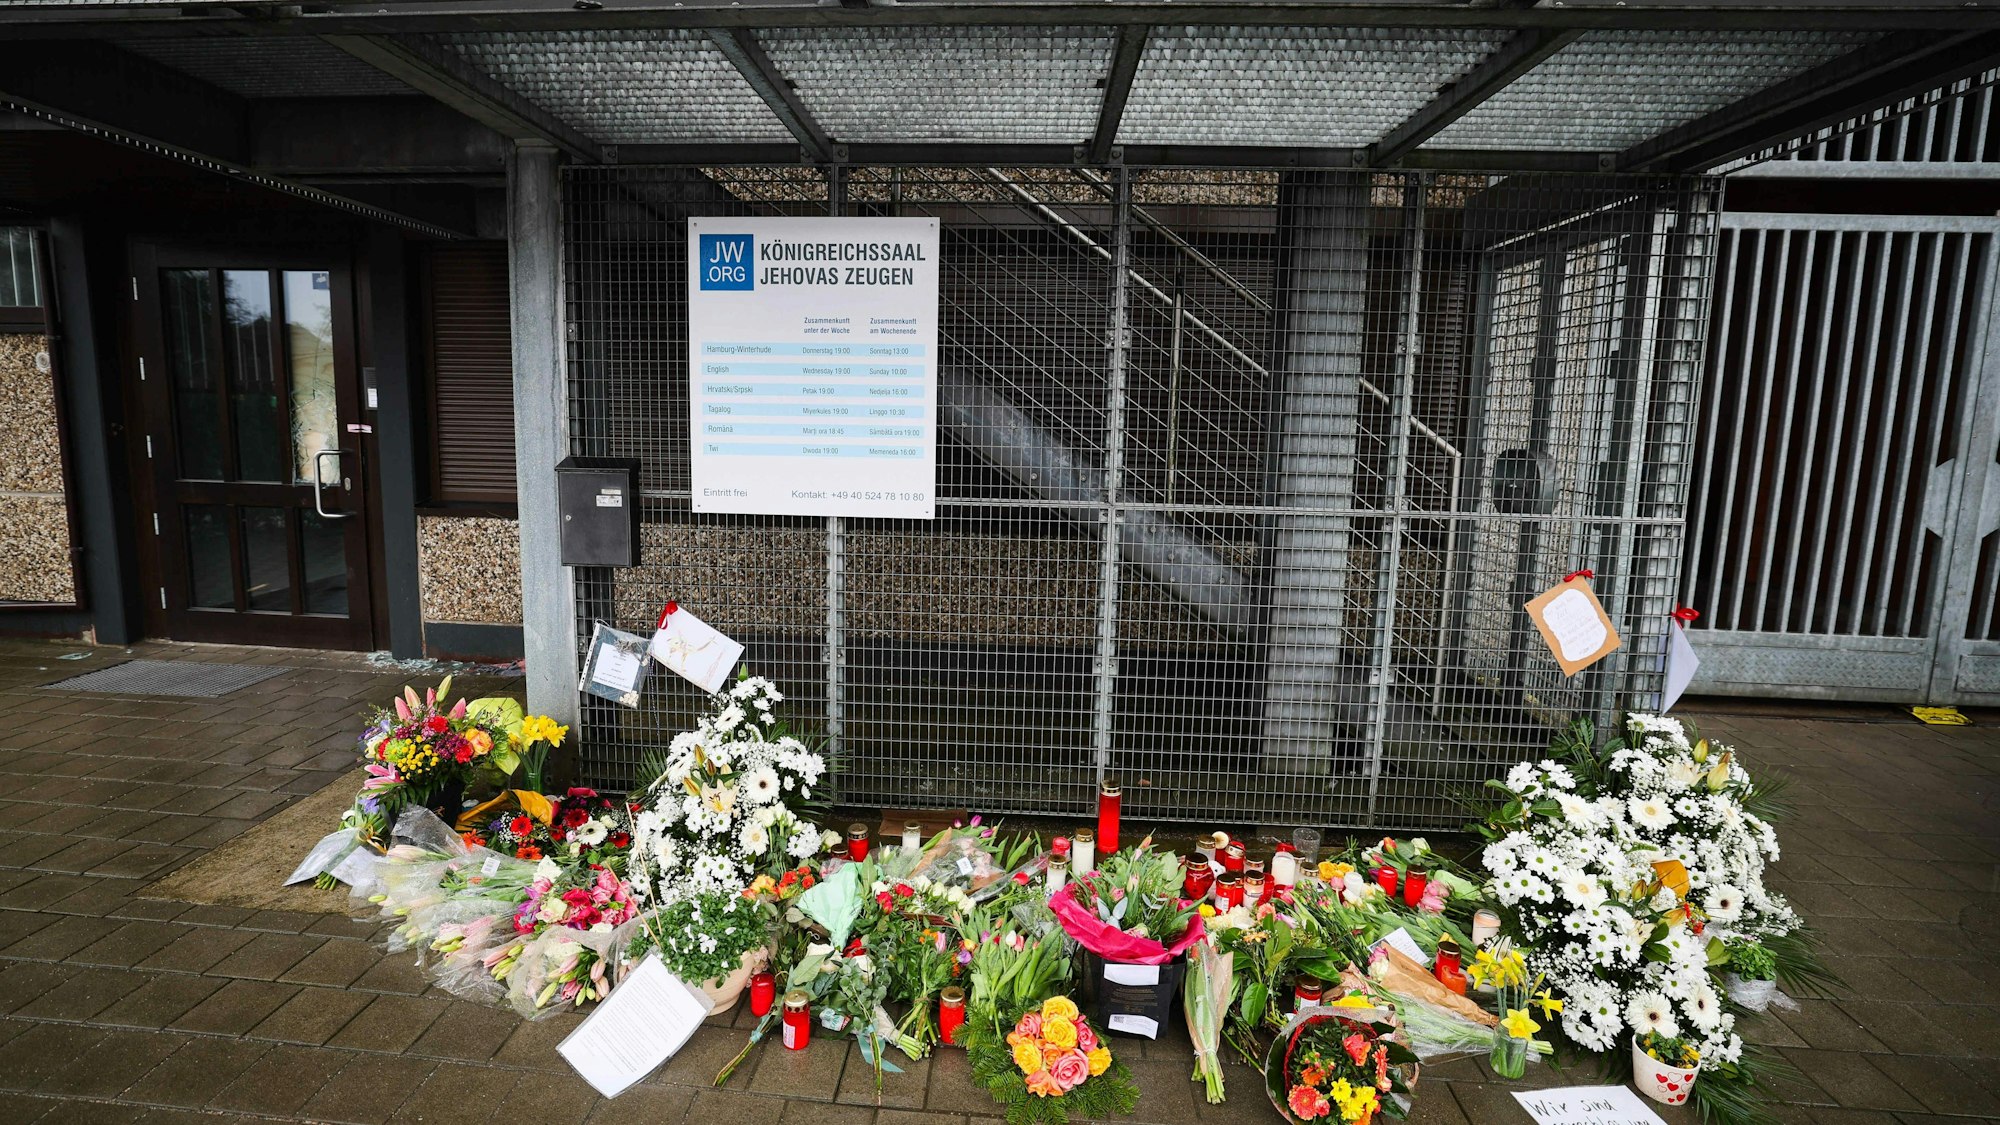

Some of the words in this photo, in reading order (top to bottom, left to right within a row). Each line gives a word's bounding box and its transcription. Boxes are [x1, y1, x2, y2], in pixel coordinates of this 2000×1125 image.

[710, 241, 744, 264] JW
[760, 239, 926, 262] KÖNIGREICHSSAAL
[706, 266, 746, 283] .ORG
[760, 267, 838, 286] JEHOVAS
[845, 267, 913, 286] ZEUGEN
[870, 317, 917, 325] Zusammenkunft
[804, 327, 818, 335] unter
[880, 327, 917, 335] Wochenende
[706, 345, 772, 355] Hamburg-Winterhude
[802, 347, 833, 356] Donnerstag
[869, 347, 892, 356] Sonntag
[707, 365, 730, 375] English
[802, 367, 833, 376] Wednesday
[834, 367, 851, 375] 19:00
[869, 368, 890, 376] Sunday
[707, 385, 753, 395] Hrvatski/Srpski
[707, 405, 731, 415] Tagalog
[869, 408, 888, 417] Linggo
[889, 408, 905, 416] 10:30
[703, 488, 732, 497] Eintritt
[733, 488, 748, 498] frei
[791, 490, 828, 500] Kontakt:
[831, 490, 849, 500] +49
[850, 491, 863, 500] 40
[864, 491, 882, 501] 524
[884, 491, 896, 501] 78
[899, 492, 910, 501] 10
[912, 492, 924, 502] 80
[1524, 1099, 1568, 1117] Wir
